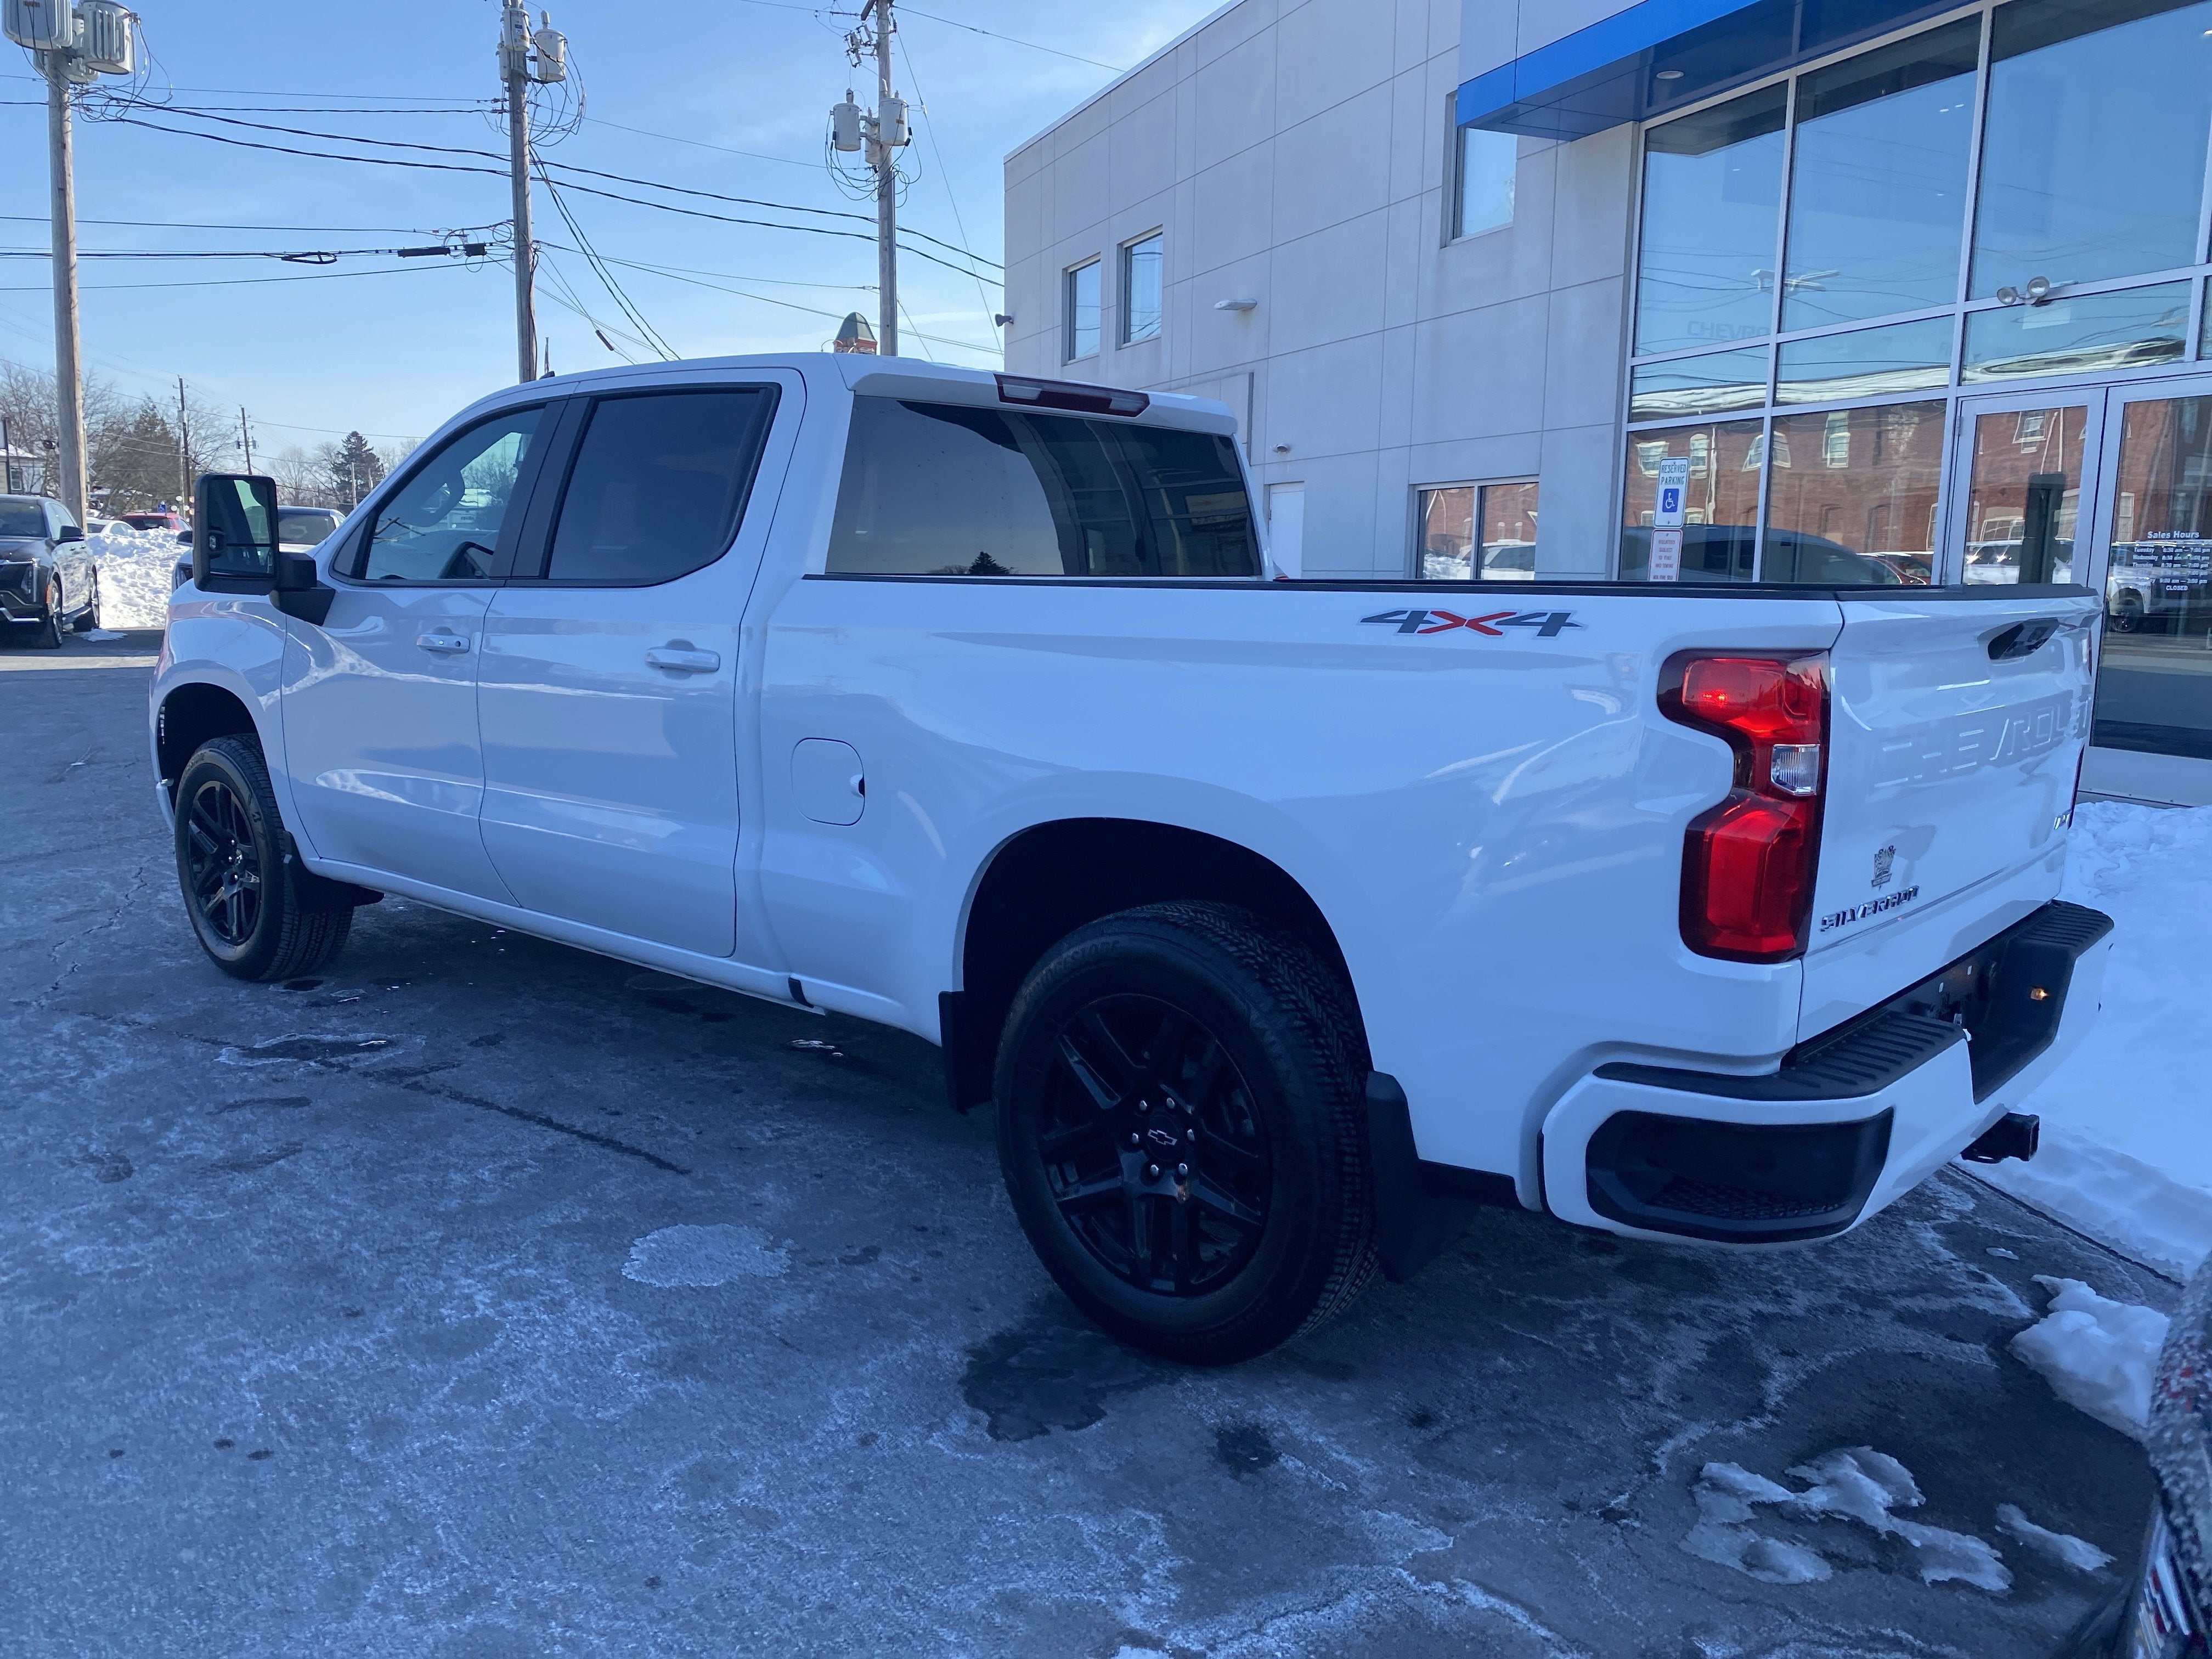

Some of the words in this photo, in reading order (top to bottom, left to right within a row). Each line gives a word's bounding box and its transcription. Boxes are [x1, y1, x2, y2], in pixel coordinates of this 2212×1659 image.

[1661, 464, 1686, 473] RESERVED
[1660, 476, 1685, 485] PARKING
[2147, 531, 2171, 539] Sales
[1819, 884, 1920, 932] SILVERADO
